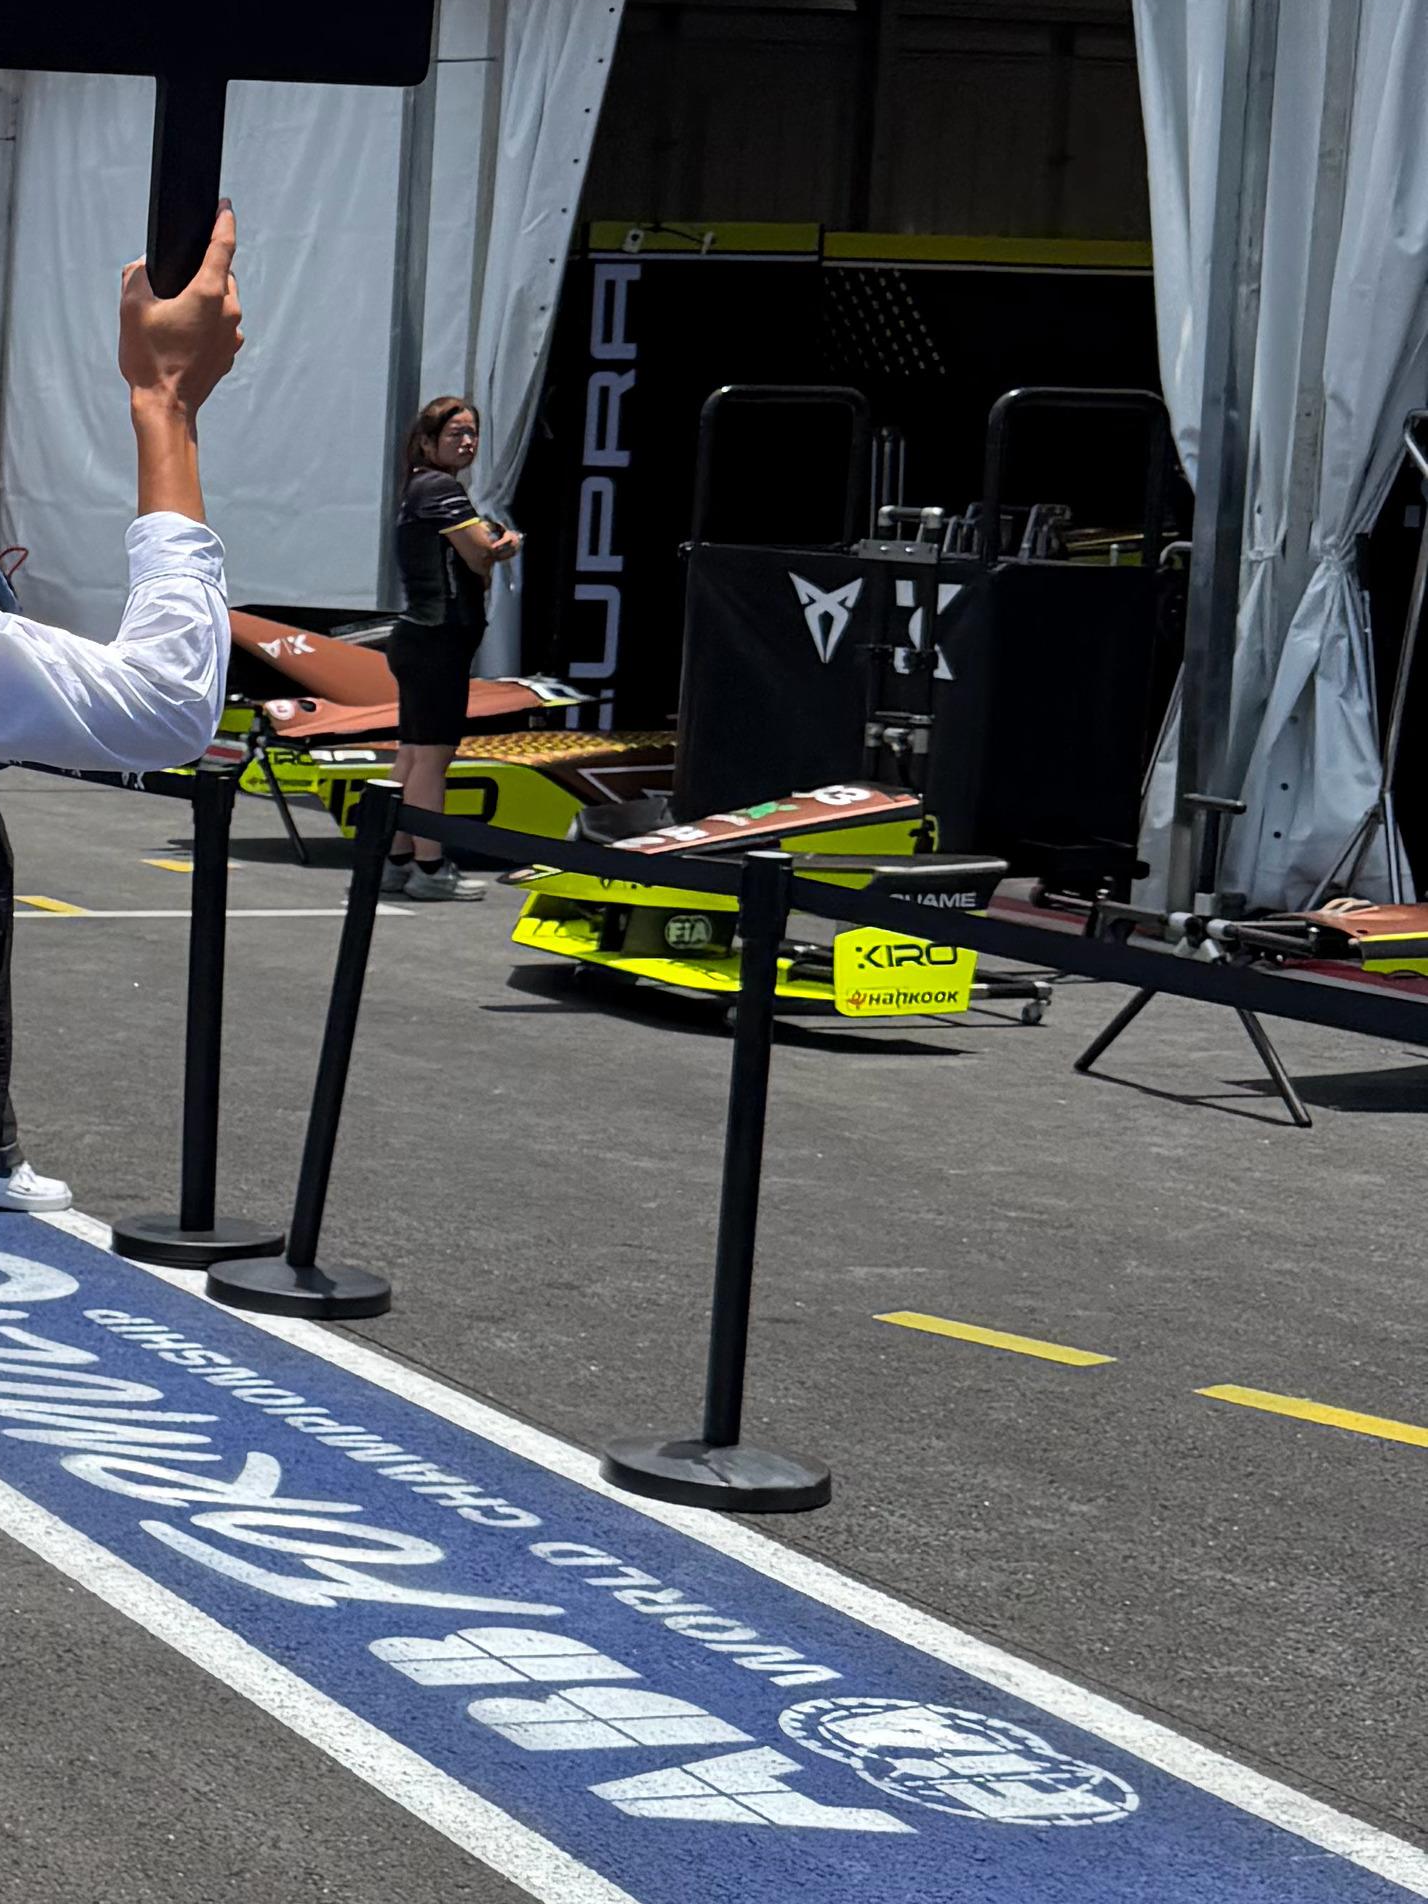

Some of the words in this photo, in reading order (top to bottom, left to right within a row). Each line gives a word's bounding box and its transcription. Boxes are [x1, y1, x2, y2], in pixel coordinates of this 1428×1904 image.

[855, 943, 958, 969] KIRO
[82, 1308, 542, 1529] CHAMPIONSHIP
[529, 1540, 844, 1688] WORLD
[367, 1626, 919, 1835] ABB
